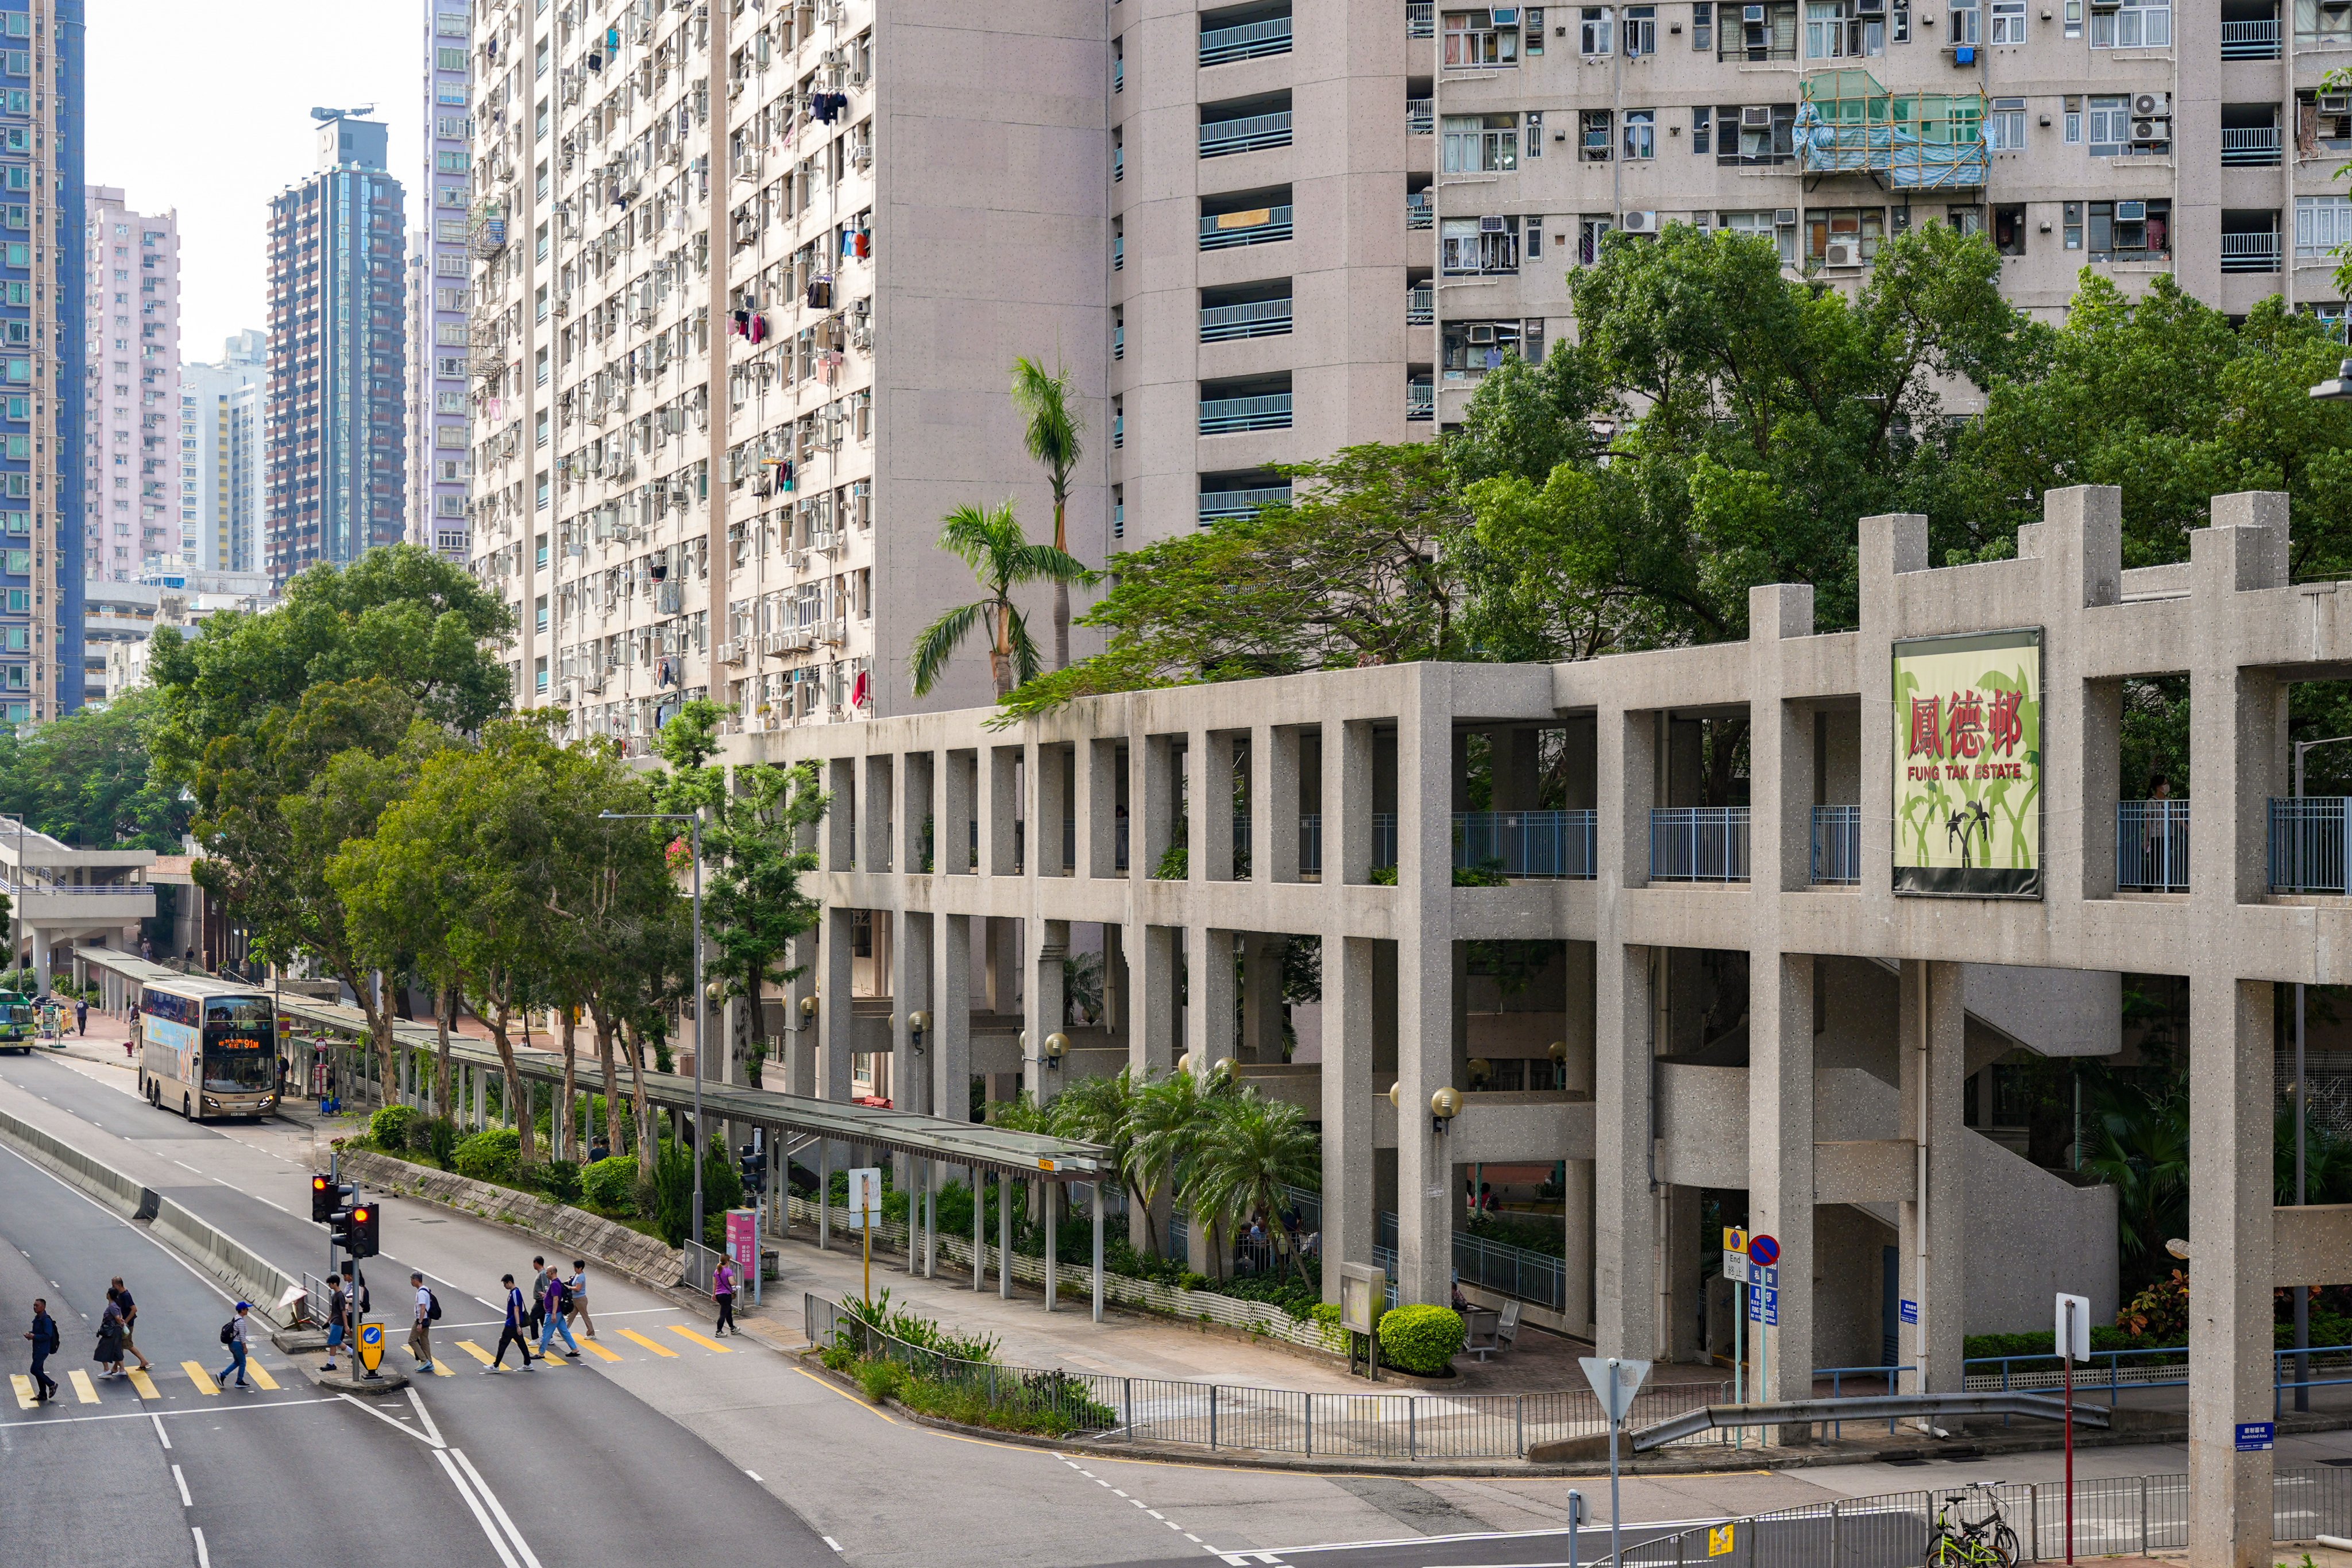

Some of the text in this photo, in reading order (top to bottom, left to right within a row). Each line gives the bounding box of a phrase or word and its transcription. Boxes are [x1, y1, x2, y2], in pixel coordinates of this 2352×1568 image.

[1907, 689, 2022, 759] 鳳德邨
[1907, 763, 2022, 781] FUNG TAK ESTATE
[244, 1039, 259, 1048] 91M
[1730, 1254, 1741, 1264] End
[1728, 1265, 1742, 1277] 終止
[1755, 1270, 1772, 1283] 私路
[1755, 1288, 1772, 1303] 鳳邨
